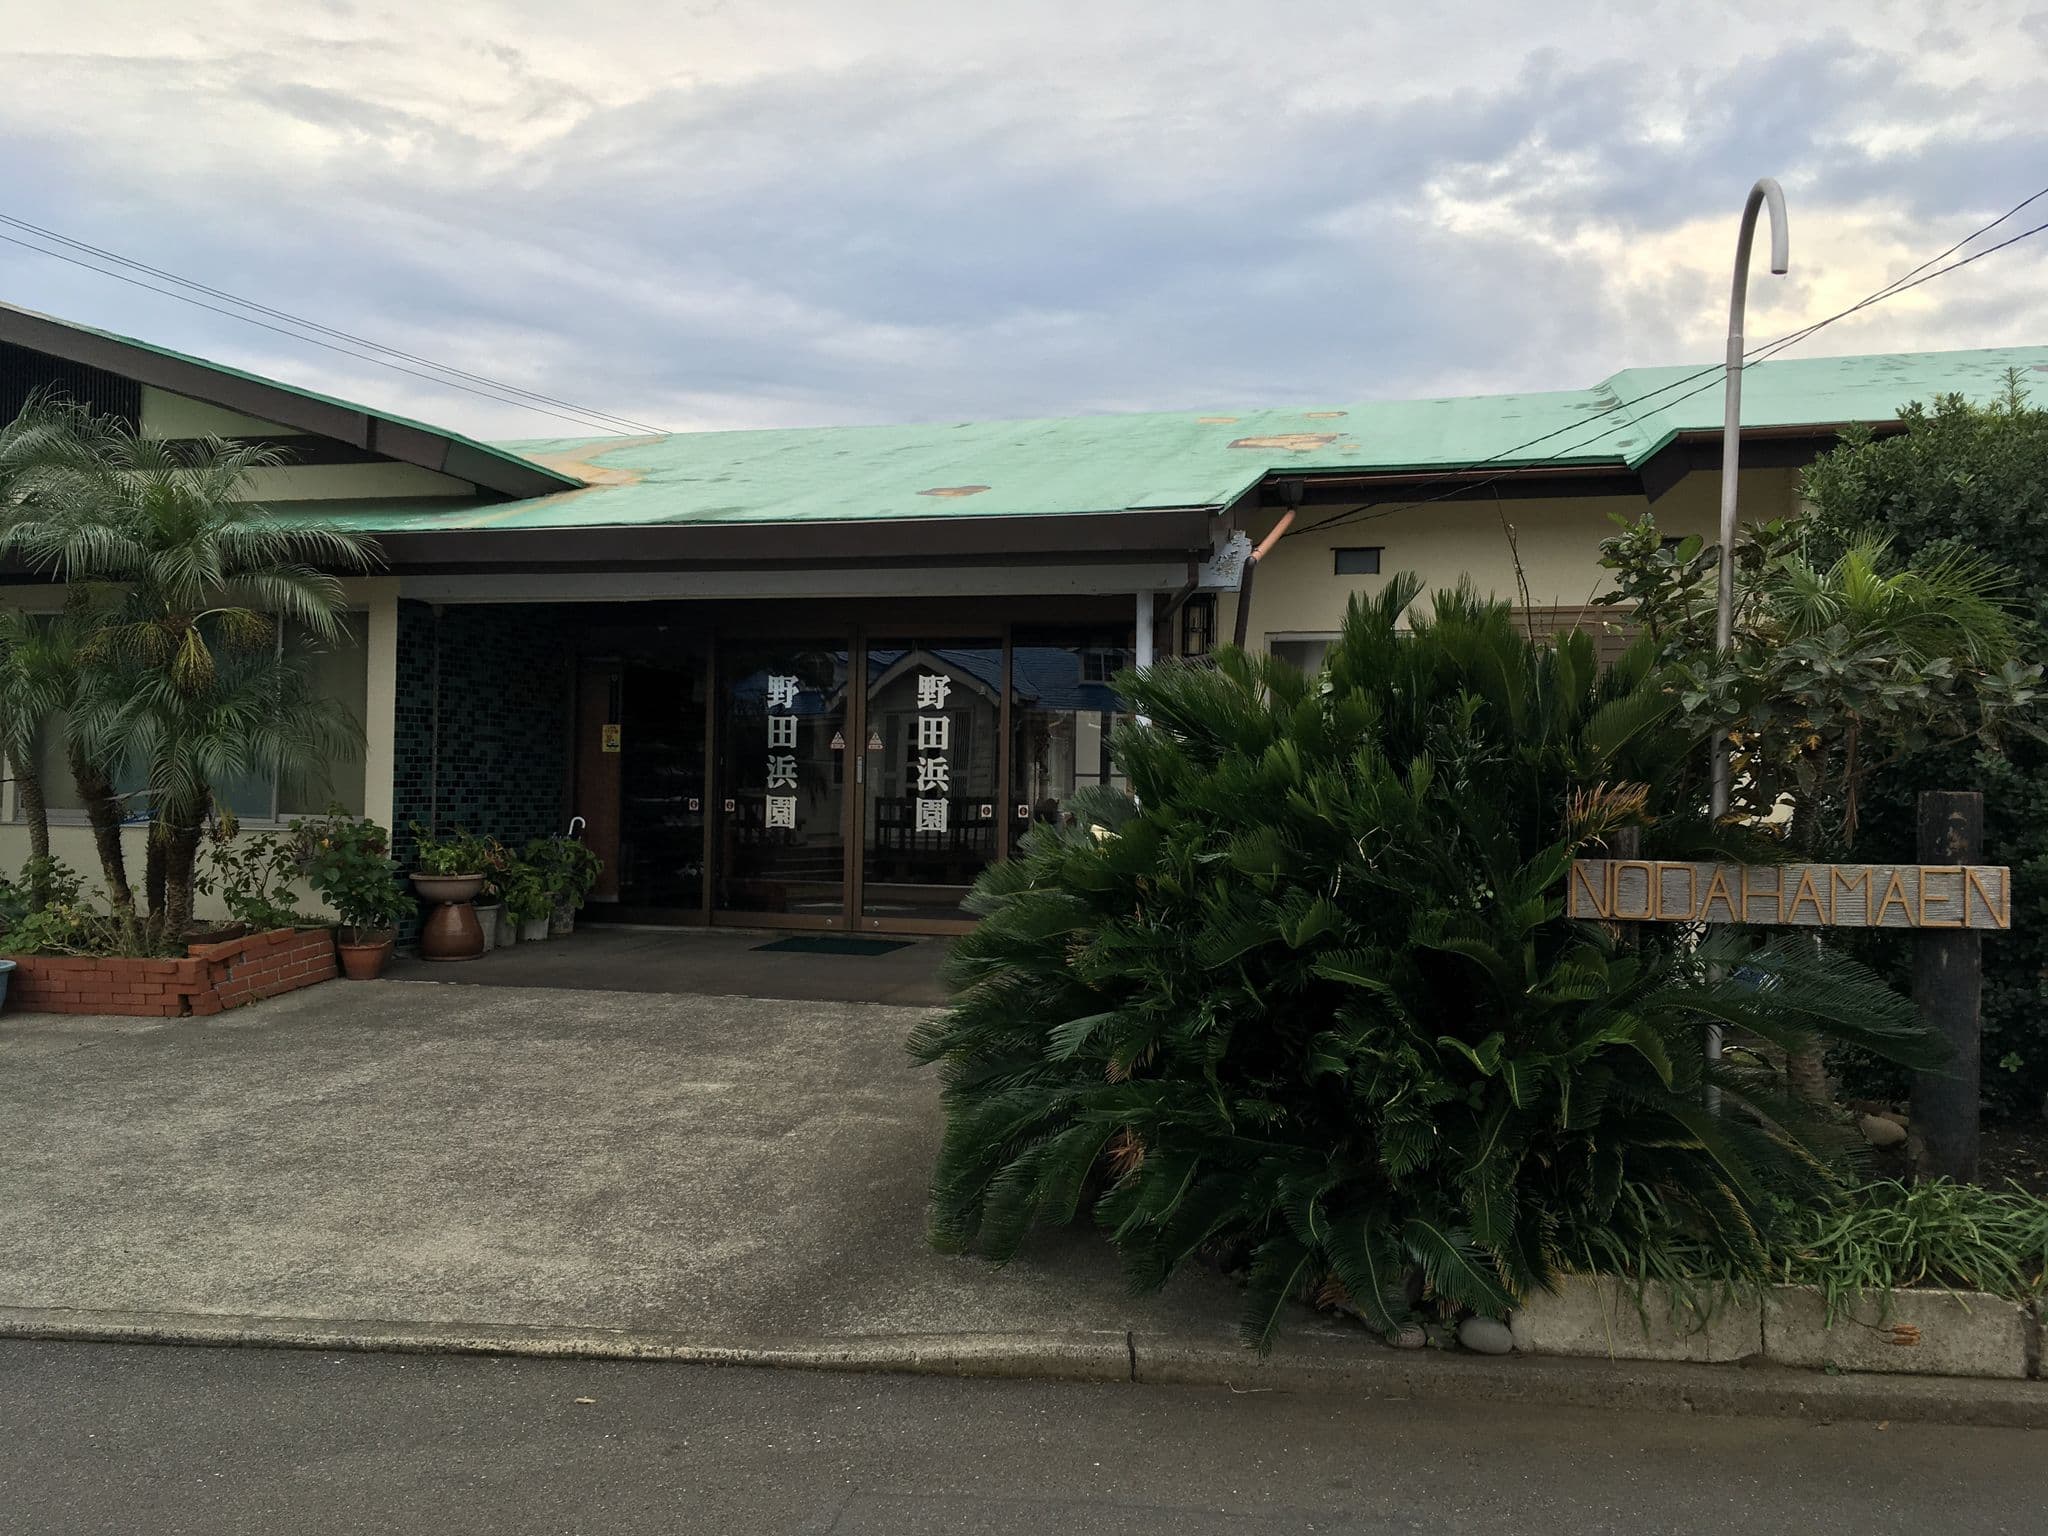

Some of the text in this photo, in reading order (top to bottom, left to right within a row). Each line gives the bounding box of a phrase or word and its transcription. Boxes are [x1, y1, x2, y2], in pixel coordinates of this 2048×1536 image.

[765, 675, 799, 829] 野田浜園
[915, 675, 951, 833] 野田浜園
[1570, 861, 2008, 928] NODAHAMAEN
